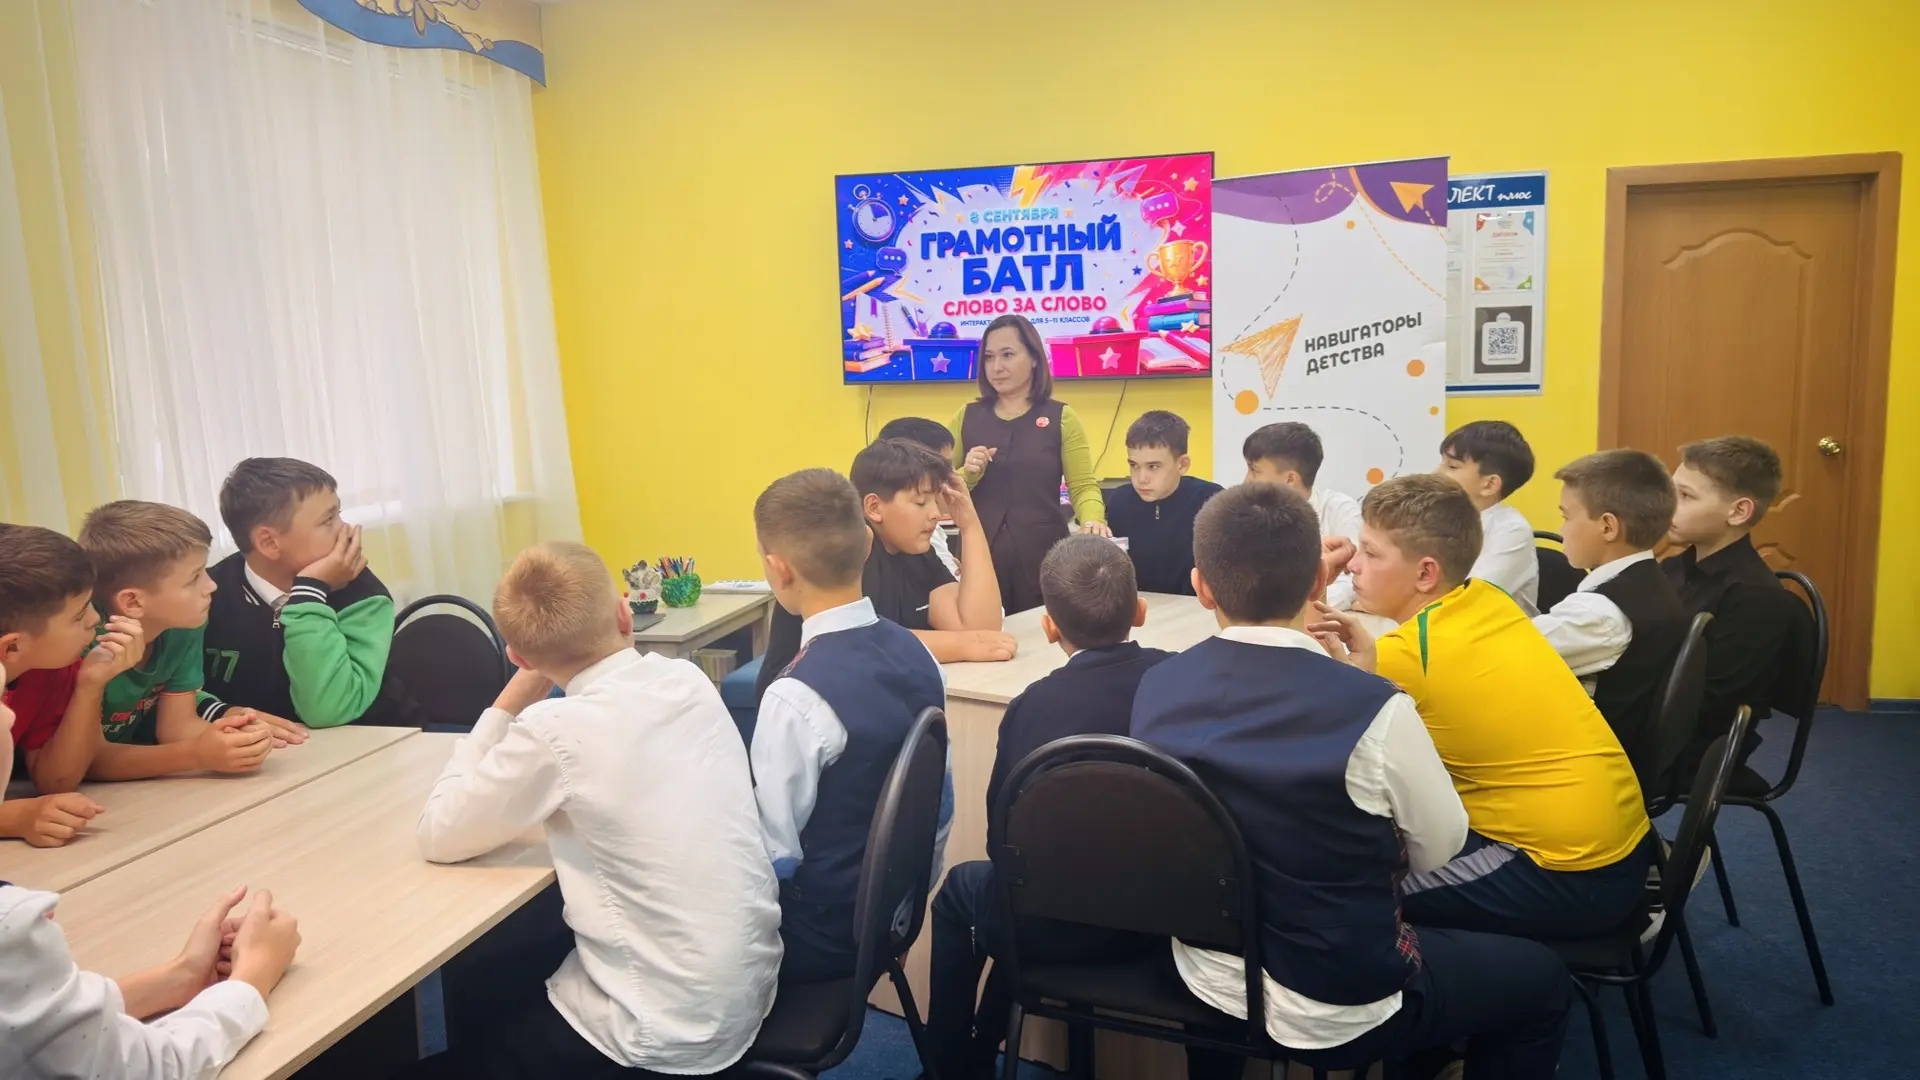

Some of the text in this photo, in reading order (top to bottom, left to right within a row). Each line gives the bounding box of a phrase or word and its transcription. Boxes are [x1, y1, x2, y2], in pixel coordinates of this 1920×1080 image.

[1447, 184, 1533, 204] ЛЕКТ плюс
[969, 207, 1060, 224] 8 СЕНТЯБРЯ
[920, 213, 1122, 260] ГРАМОТНЫЙ
[962, 253, 1085, 295] БАТЛ
[943, 296, 1107, 317] СЛОВО ЗА СЛОВО
[960, 319, 992, 327] ИНТЕРАКТ
[1304, 311, 1422, 353] НАВИГАТОРЫ
[1306, 342, 1385, 376] ДЕТСТВА
[206, 648, 240, 683] 77
